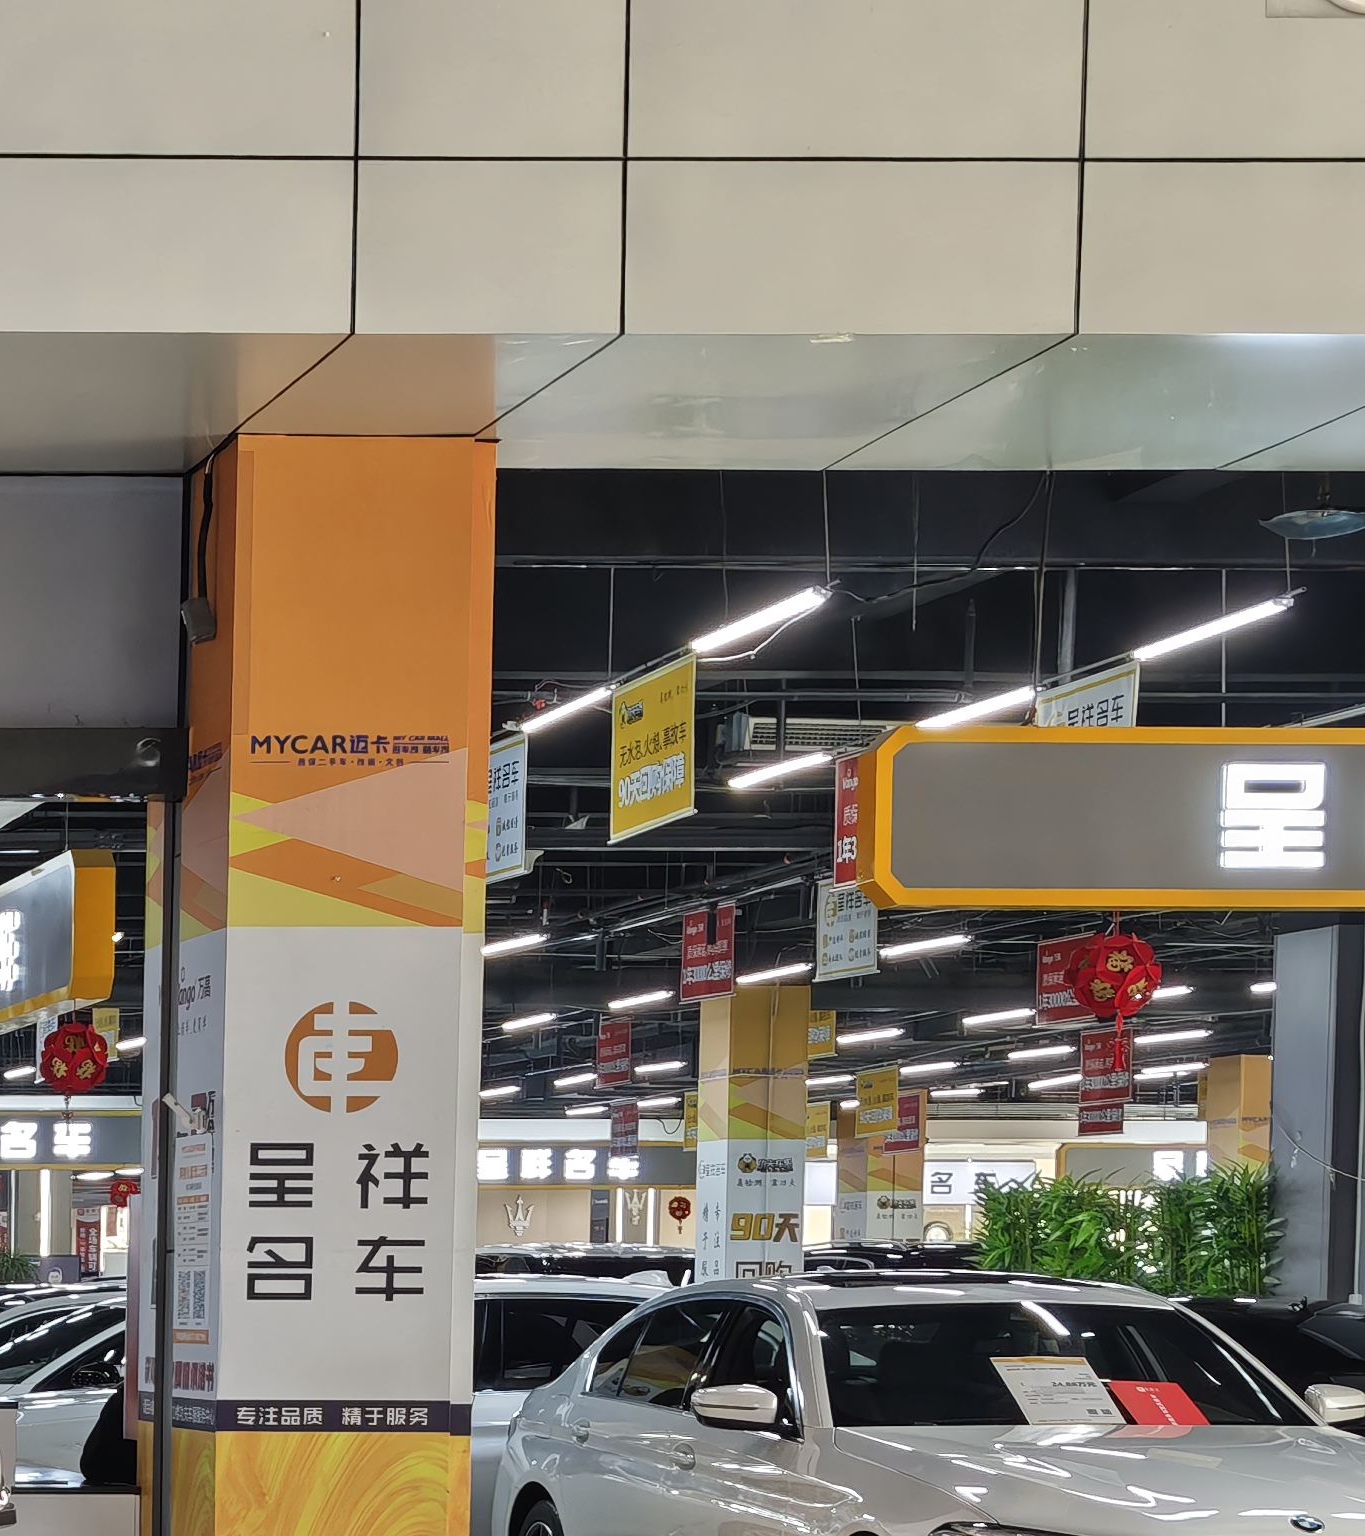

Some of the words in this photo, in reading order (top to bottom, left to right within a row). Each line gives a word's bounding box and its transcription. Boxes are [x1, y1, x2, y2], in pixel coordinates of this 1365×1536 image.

[1219, 761, 1327, 870] 呈
[729, 1213, 800, 1243] 90天
[235, 1407, 325, 1428] 专注品质
[341, 1407, 430, 1428] 精于服务
